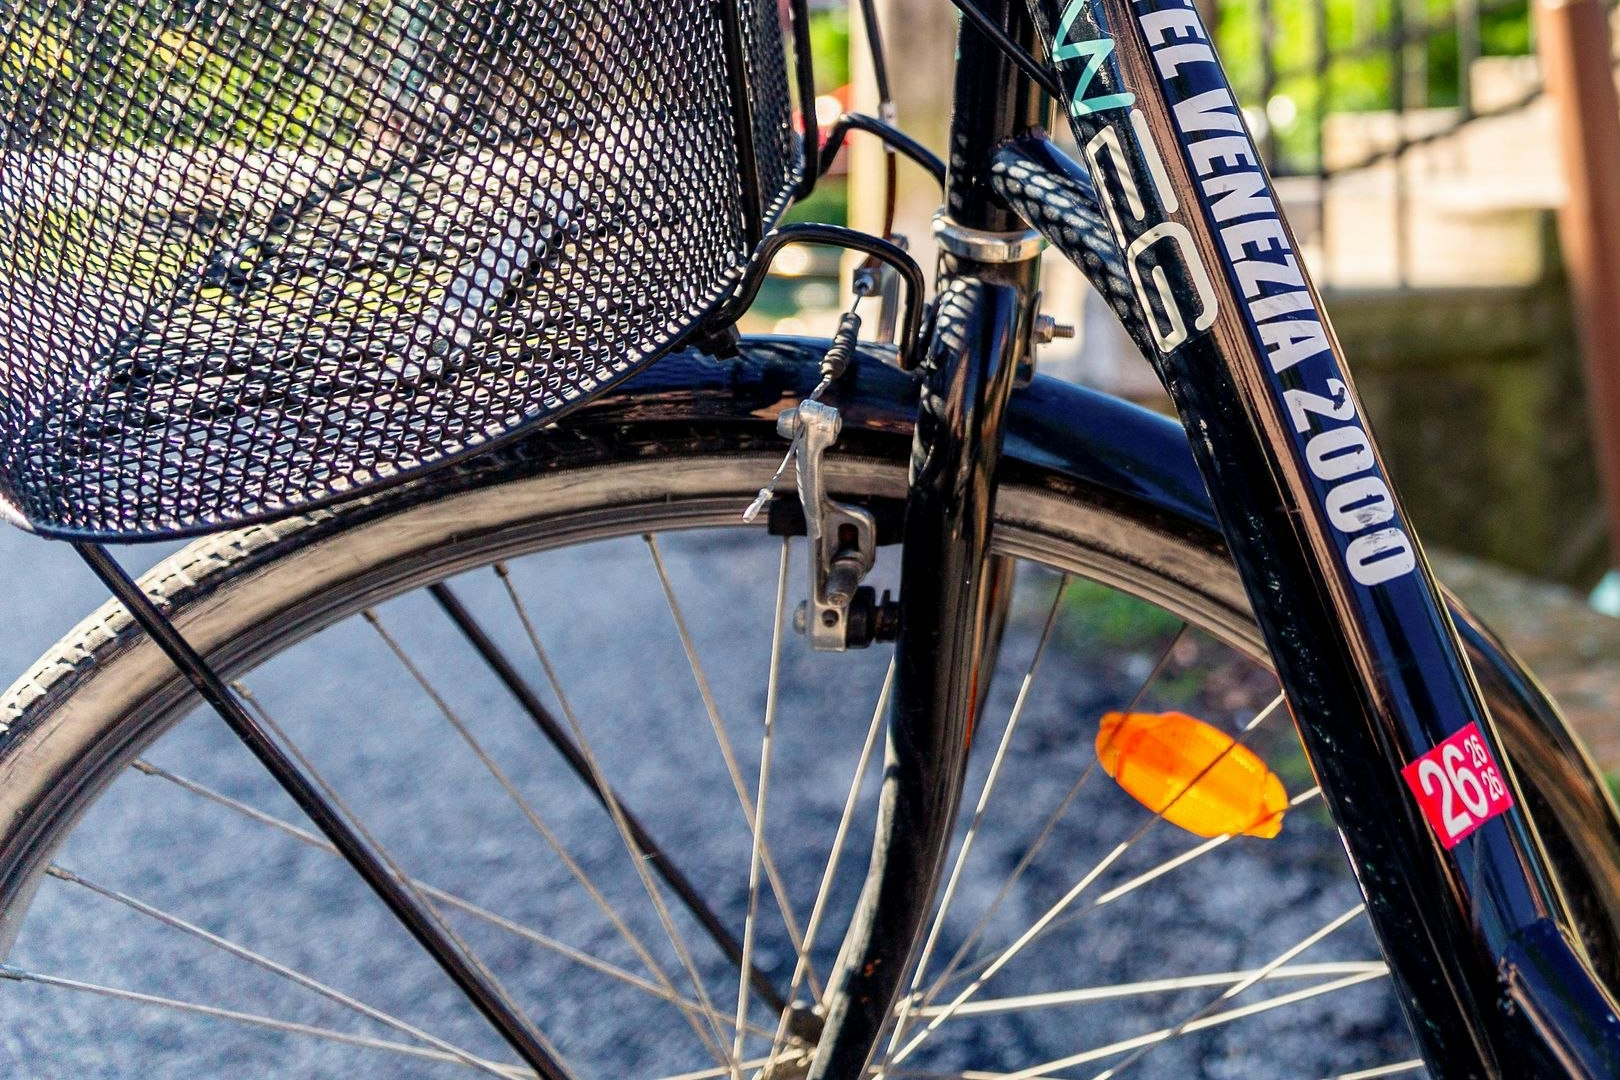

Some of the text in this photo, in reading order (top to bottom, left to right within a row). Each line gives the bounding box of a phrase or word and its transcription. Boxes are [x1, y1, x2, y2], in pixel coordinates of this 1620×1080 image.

[1173, 88, 1330, 373] VENEZIA
[1283, 378, 1415, 586] 2000
[1464, 734, 1487, 769] 26
[1418, 743, 1489, 838] 26
[1481, 767, 1504, 802] 26
